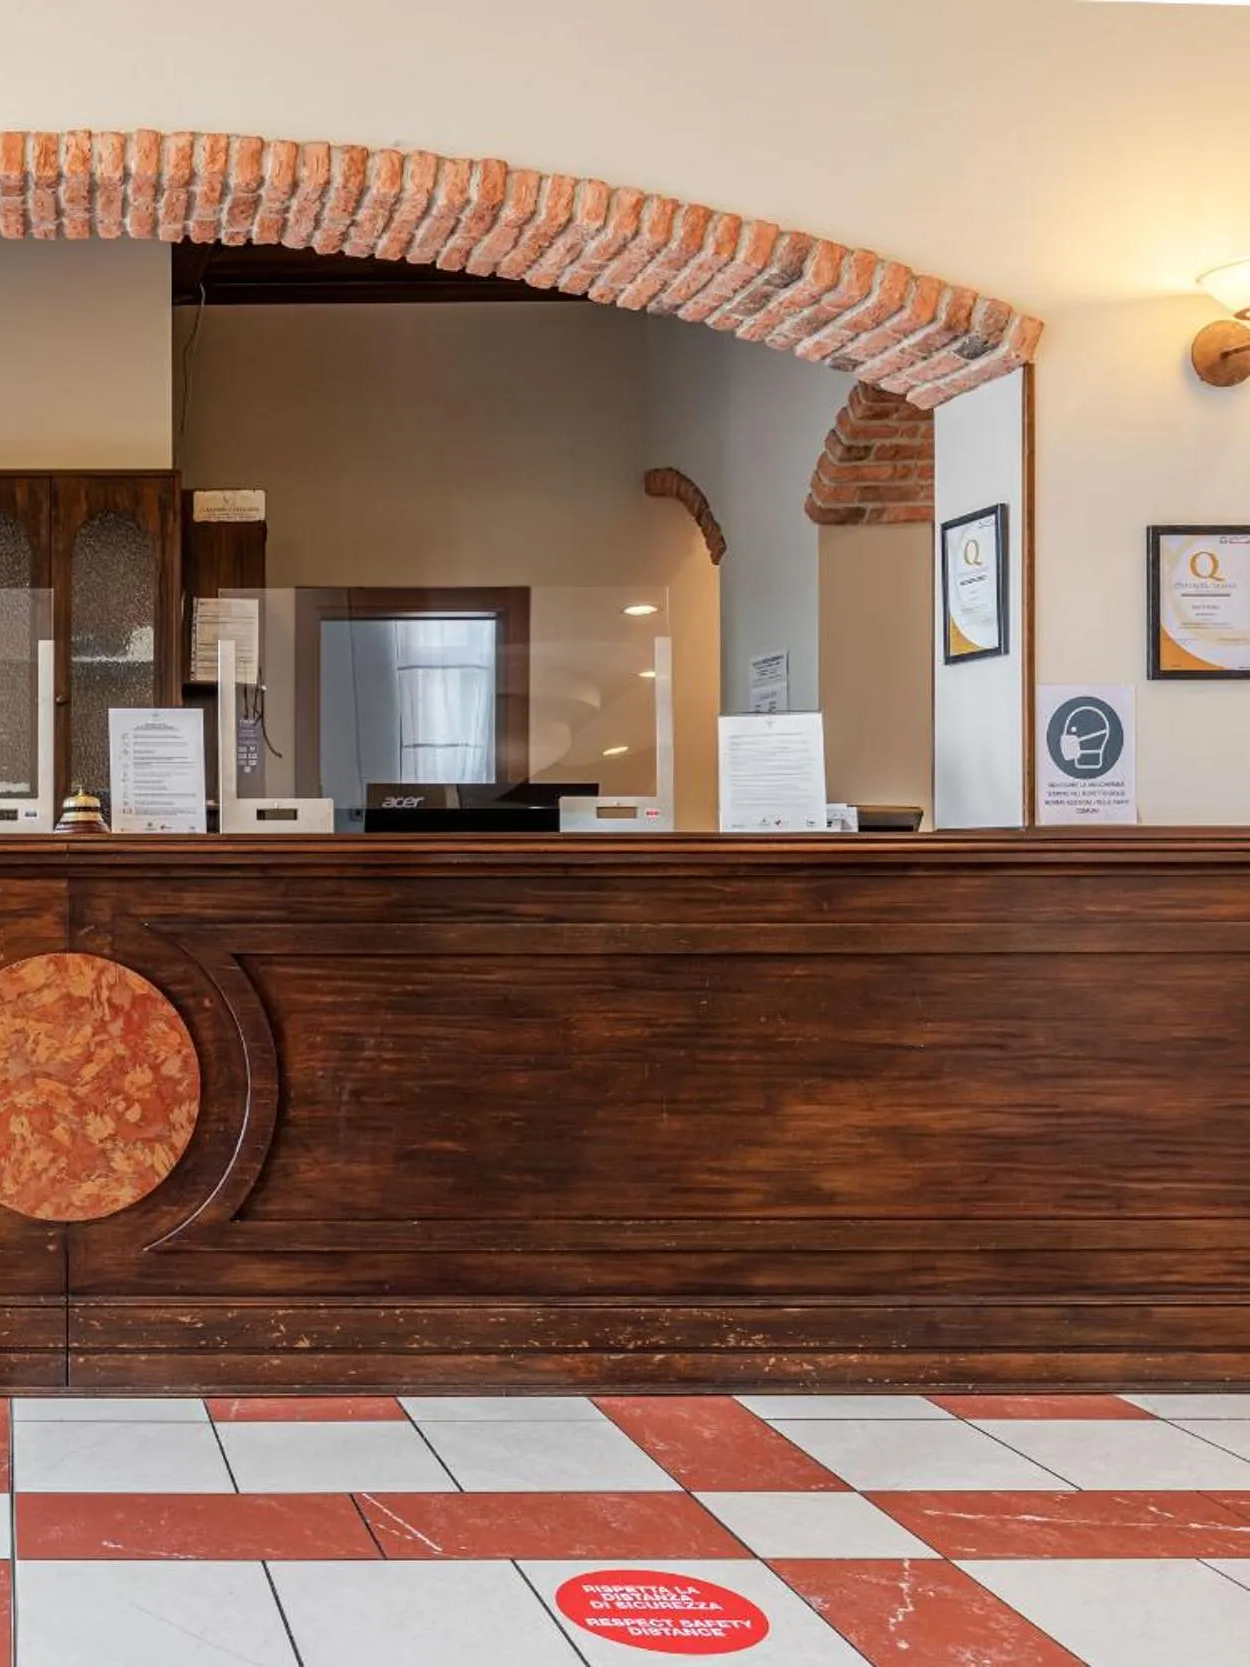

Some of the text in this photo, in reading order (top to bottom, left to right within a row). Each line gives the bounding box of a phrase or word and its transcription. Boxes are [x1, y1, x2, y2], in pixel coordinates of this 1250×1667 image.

[963, 539, 983, 566] Q
[1190, 551, 1226, 581] Q
[381, 796, 425, 808] acer
[581, 1584, 702, 1595] RISPETTA LA
[601, 1592, 695, 1602] DISTANZA
[589, 1600, 724, 1611] DI SICUREZZA
[586, 1617, 752, 1629] RESPECT SAFETY
[629, 1627, 726, 1636] DISTANCE
